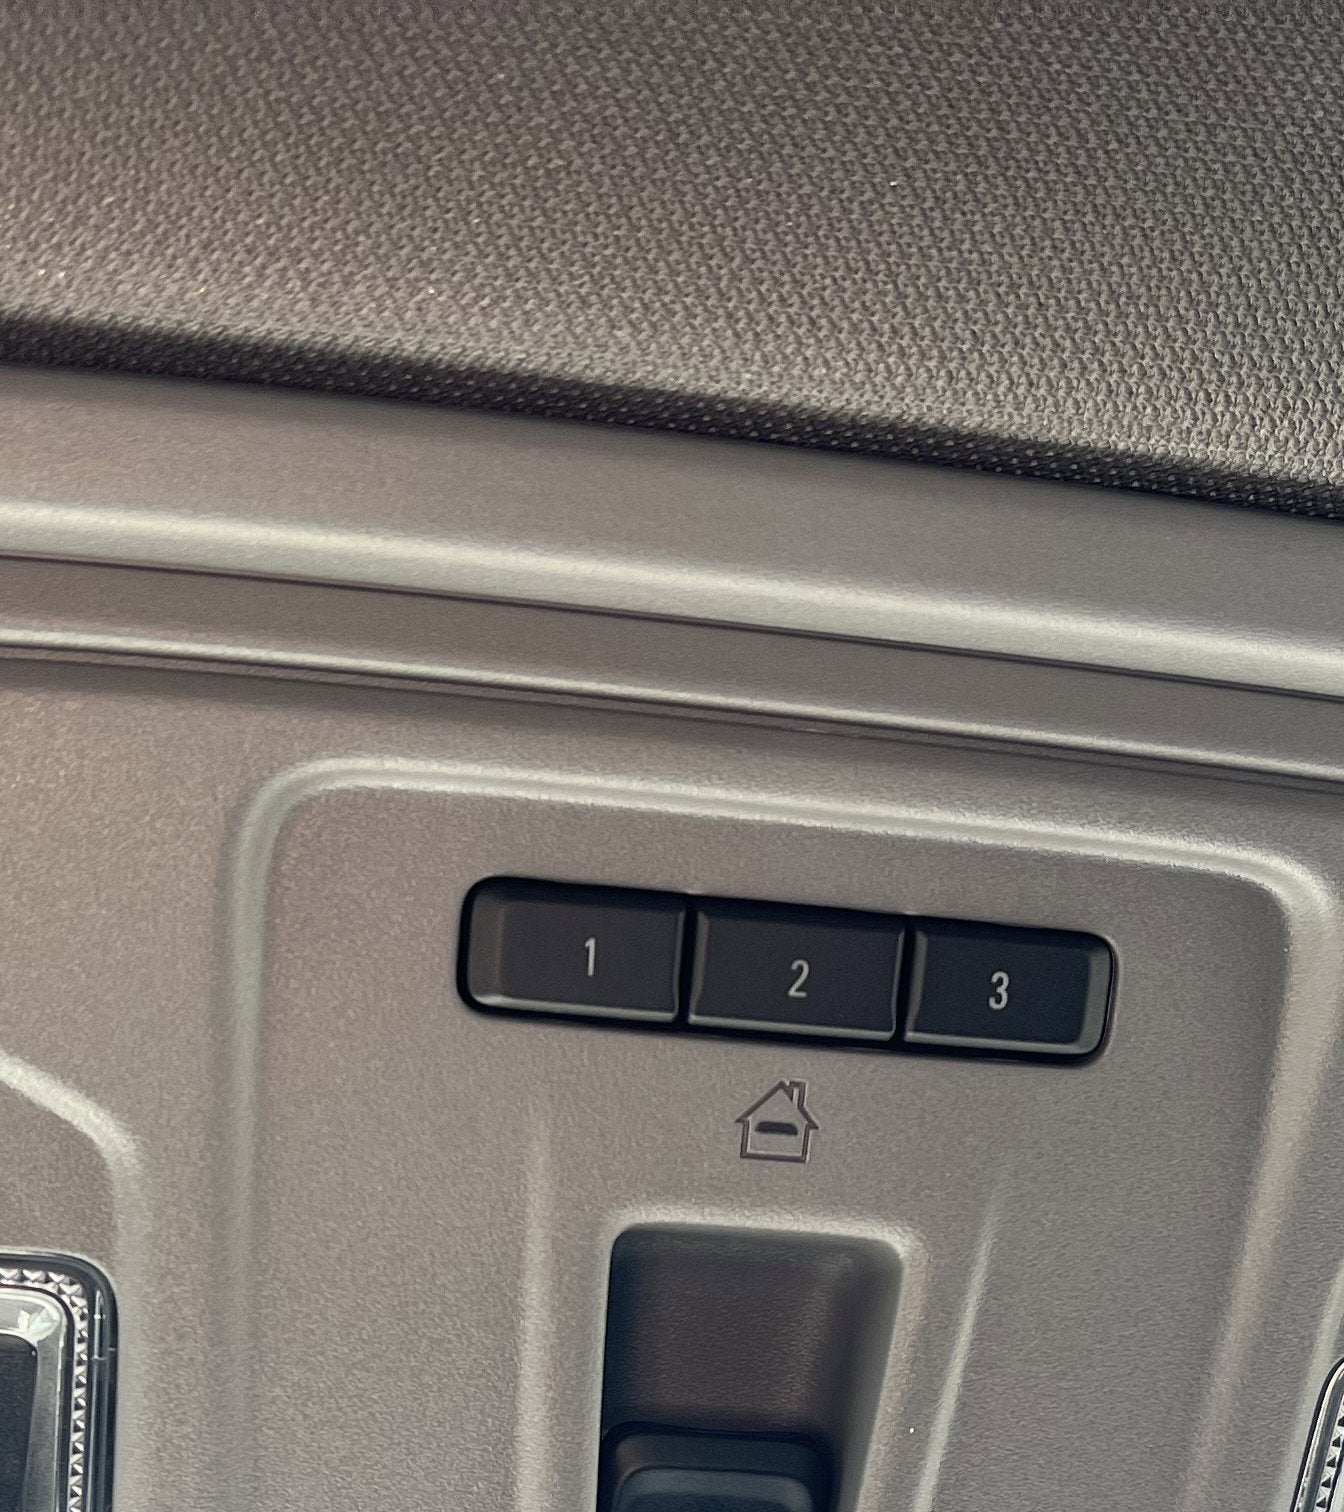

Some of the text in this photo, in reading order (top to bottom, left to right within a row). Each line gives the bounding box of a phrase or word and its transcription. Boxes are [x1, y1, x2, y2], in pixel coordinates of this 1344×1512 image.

[584, 936, 597, 978] 1
[786, 958, 811, 999] 2
[987, 970, 1010, 1011] 3
